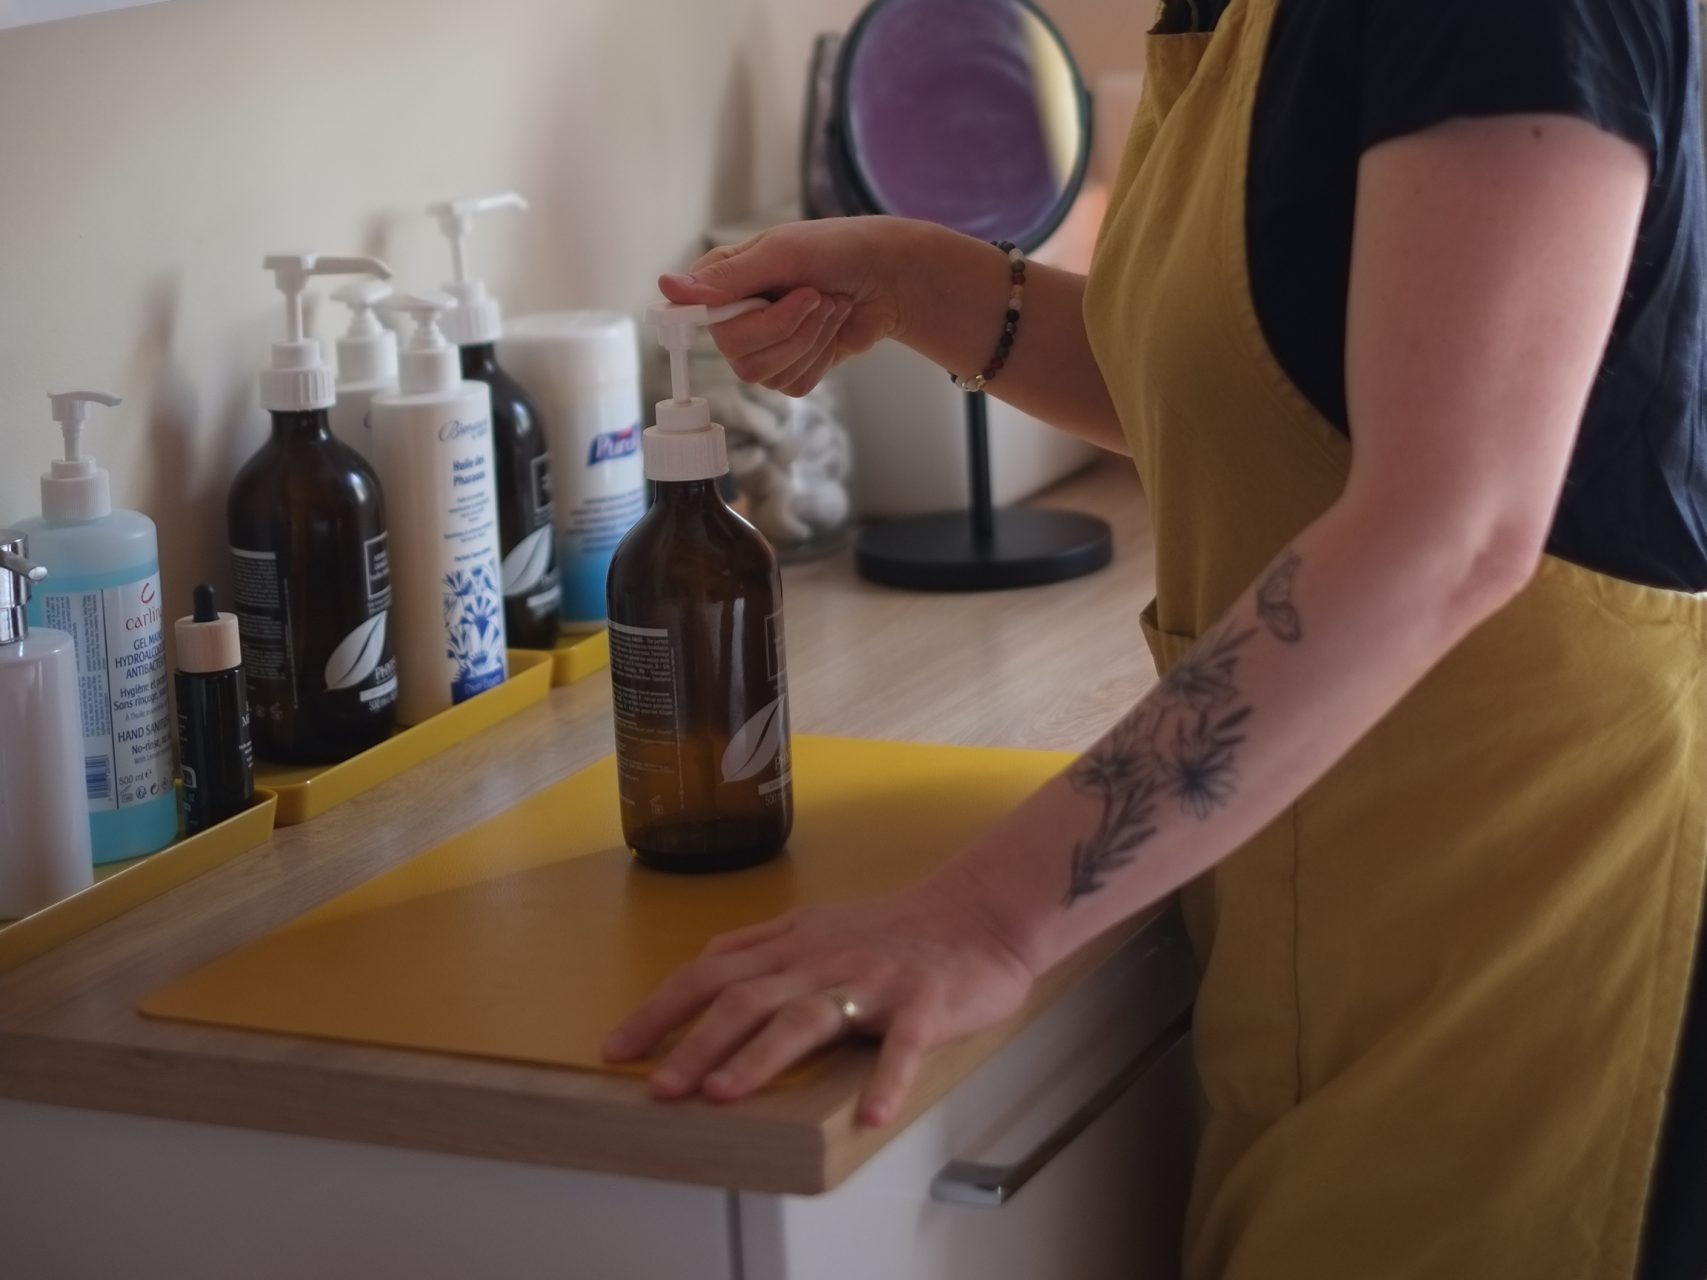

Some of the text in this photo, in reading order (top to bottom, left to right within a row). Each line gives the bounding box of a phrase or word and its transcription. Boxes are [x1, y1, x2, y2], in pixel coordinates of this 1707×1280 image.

[134, 637, 148, 651] GEL
[120, 683, 149, 699] Hygiène
[113, 699, 134, 712] Sans
[118, 725, 145, 743] HAND
[119, 773, 133, 786] 500
